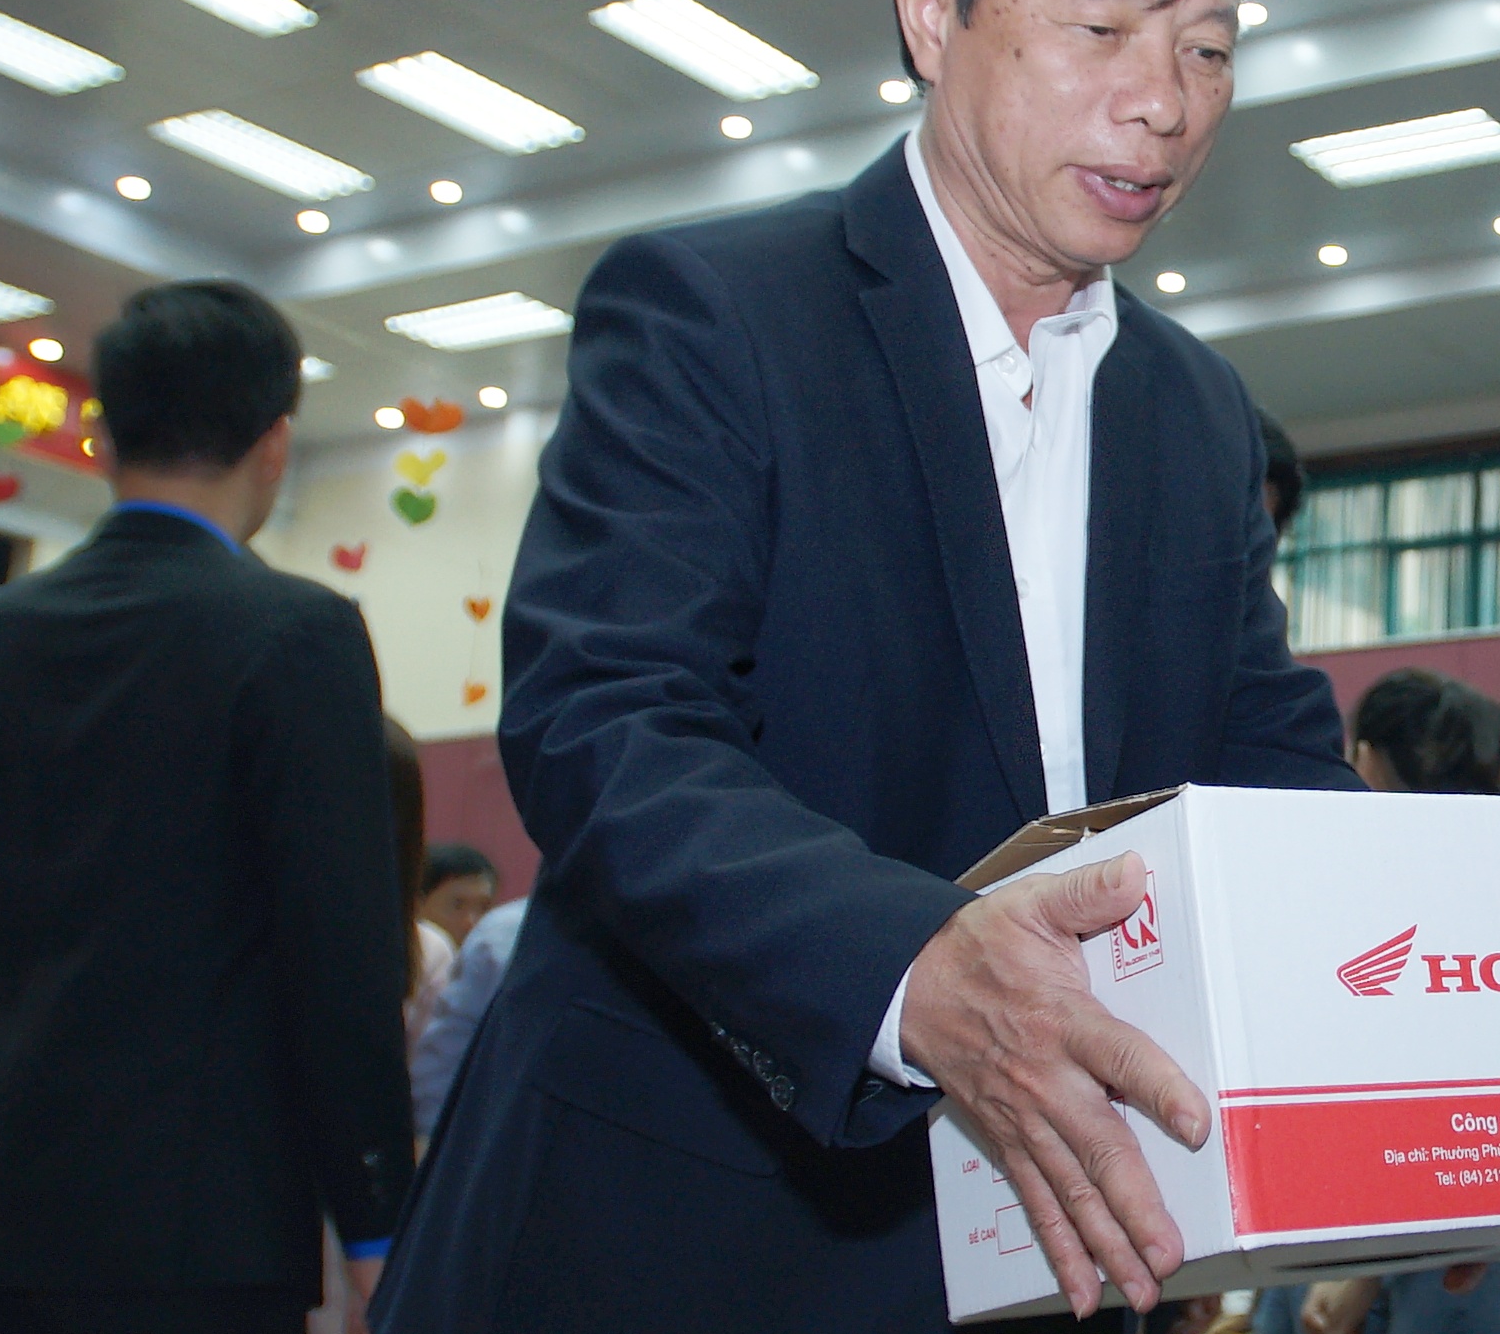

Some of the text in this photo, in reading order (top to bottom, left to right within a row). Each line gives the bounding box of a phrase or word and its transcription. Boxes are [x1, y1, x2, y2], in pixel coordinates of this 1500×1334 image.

[1451, 1113, 1498, 1134] Công
[1384, 1149, 1405, 1166] Địa
[1431, 1146, 1479, 1162] Phường
[1435, 1171, 1456, 1186] Tel:
[1459, 1169, 1483, 1186] (84)
